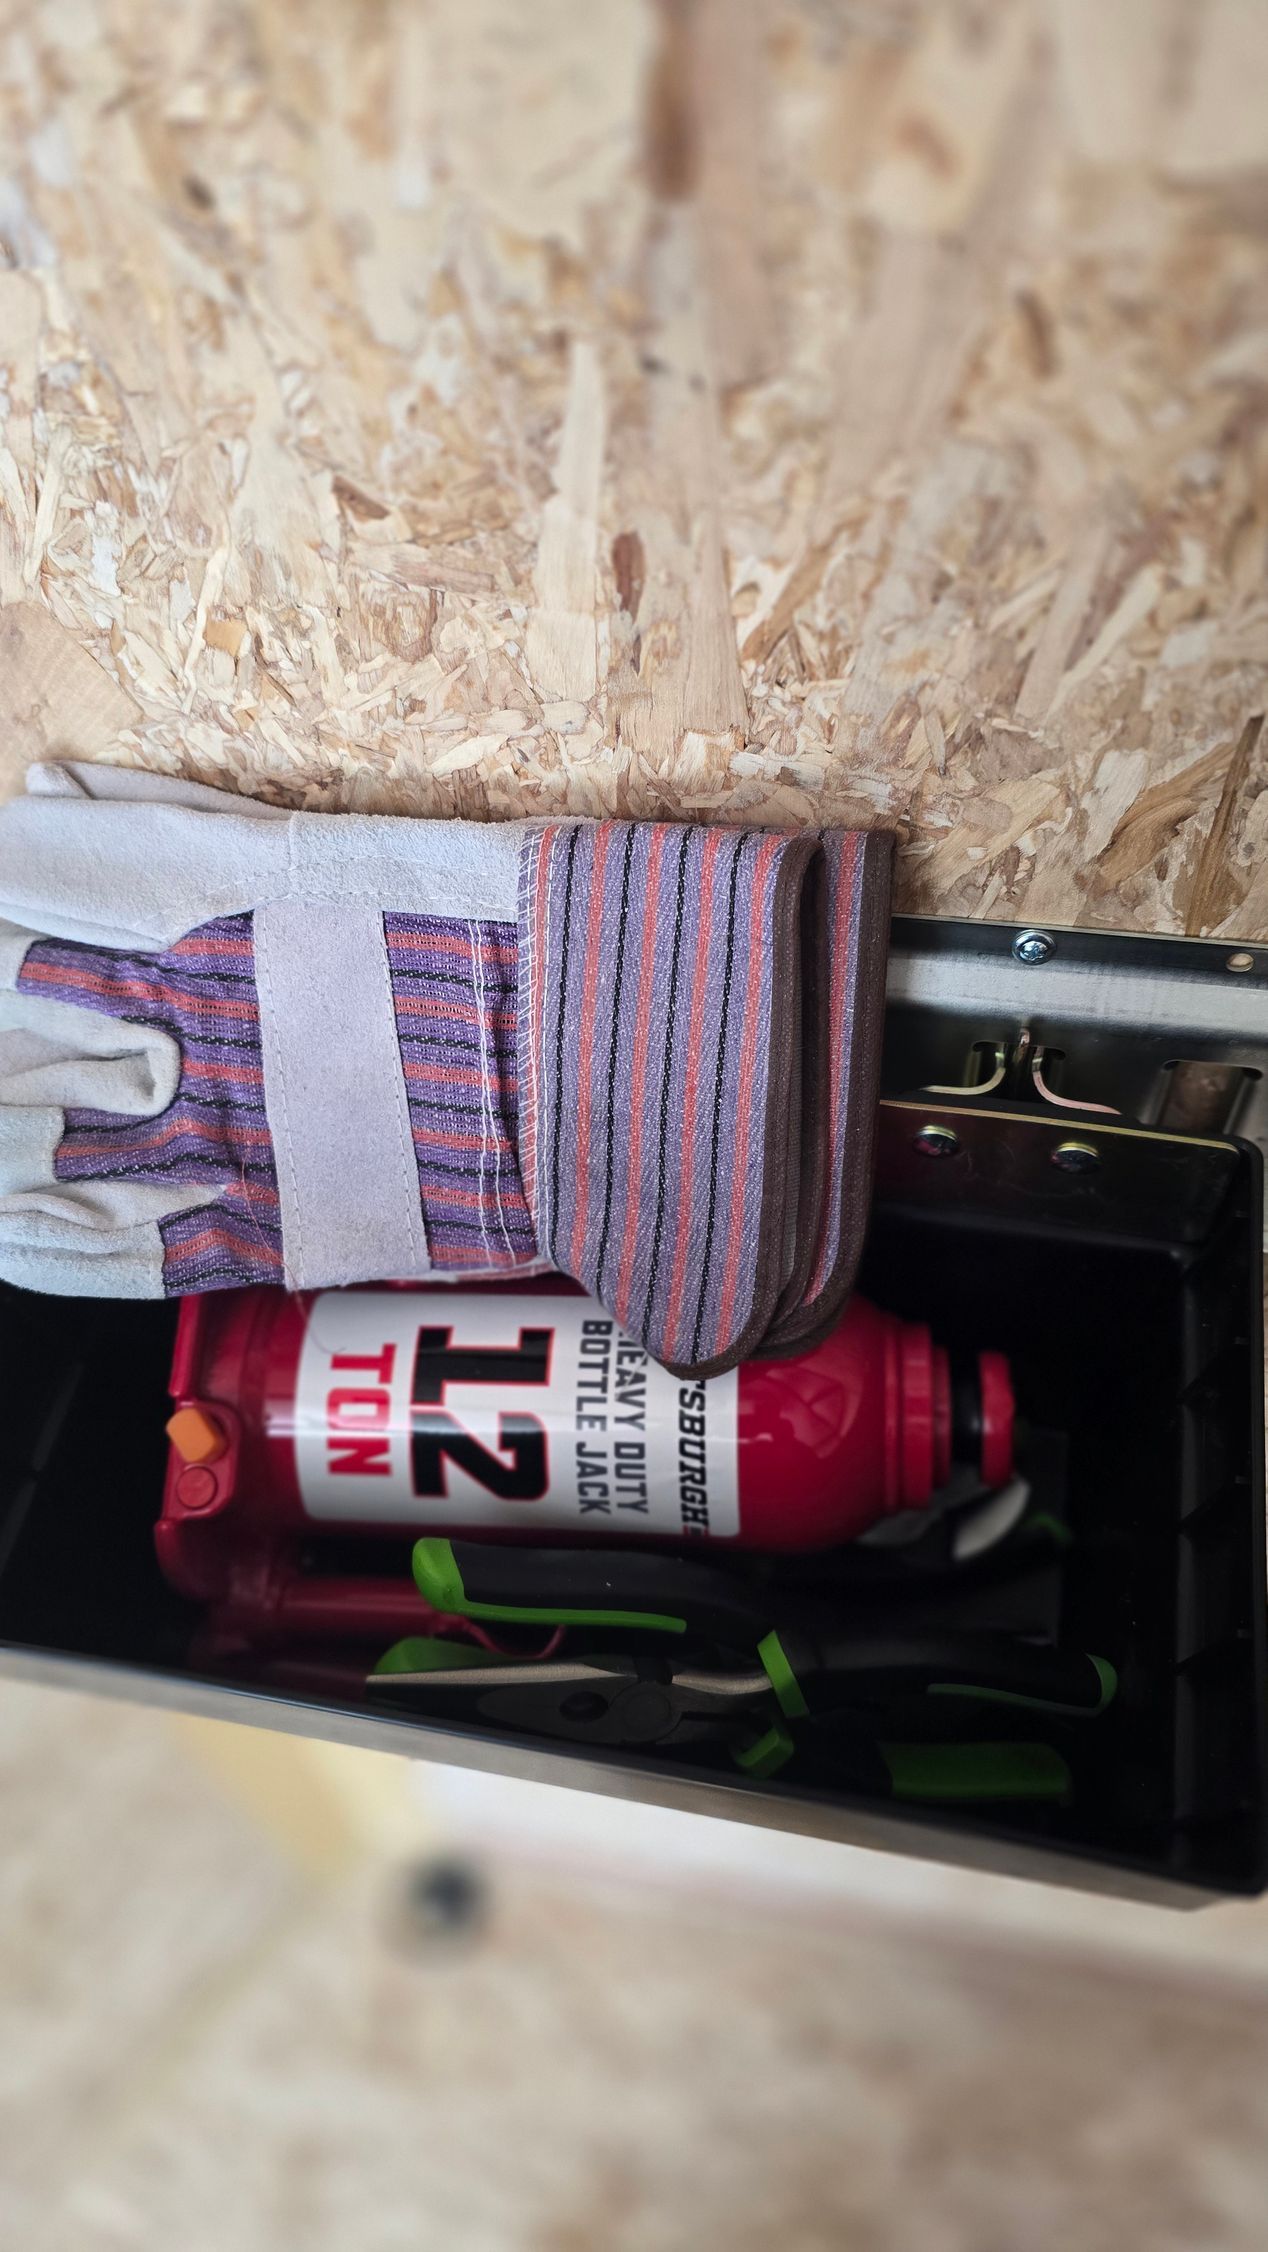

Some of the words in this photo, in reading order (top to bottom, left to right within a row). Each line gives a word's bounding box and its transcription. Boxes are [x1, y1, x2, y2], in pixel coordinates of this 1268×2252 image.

[326, 1343, 397, 1477] TON
[410, 1326, 556, 1501] 12
[576, 1320, 613, 1432] BOTTLE
[576, 1442, 611, 1515] JACK
[614, 1442, 649, 1514] DUTY
[679, 1380, 709, 1526] SBURGH
